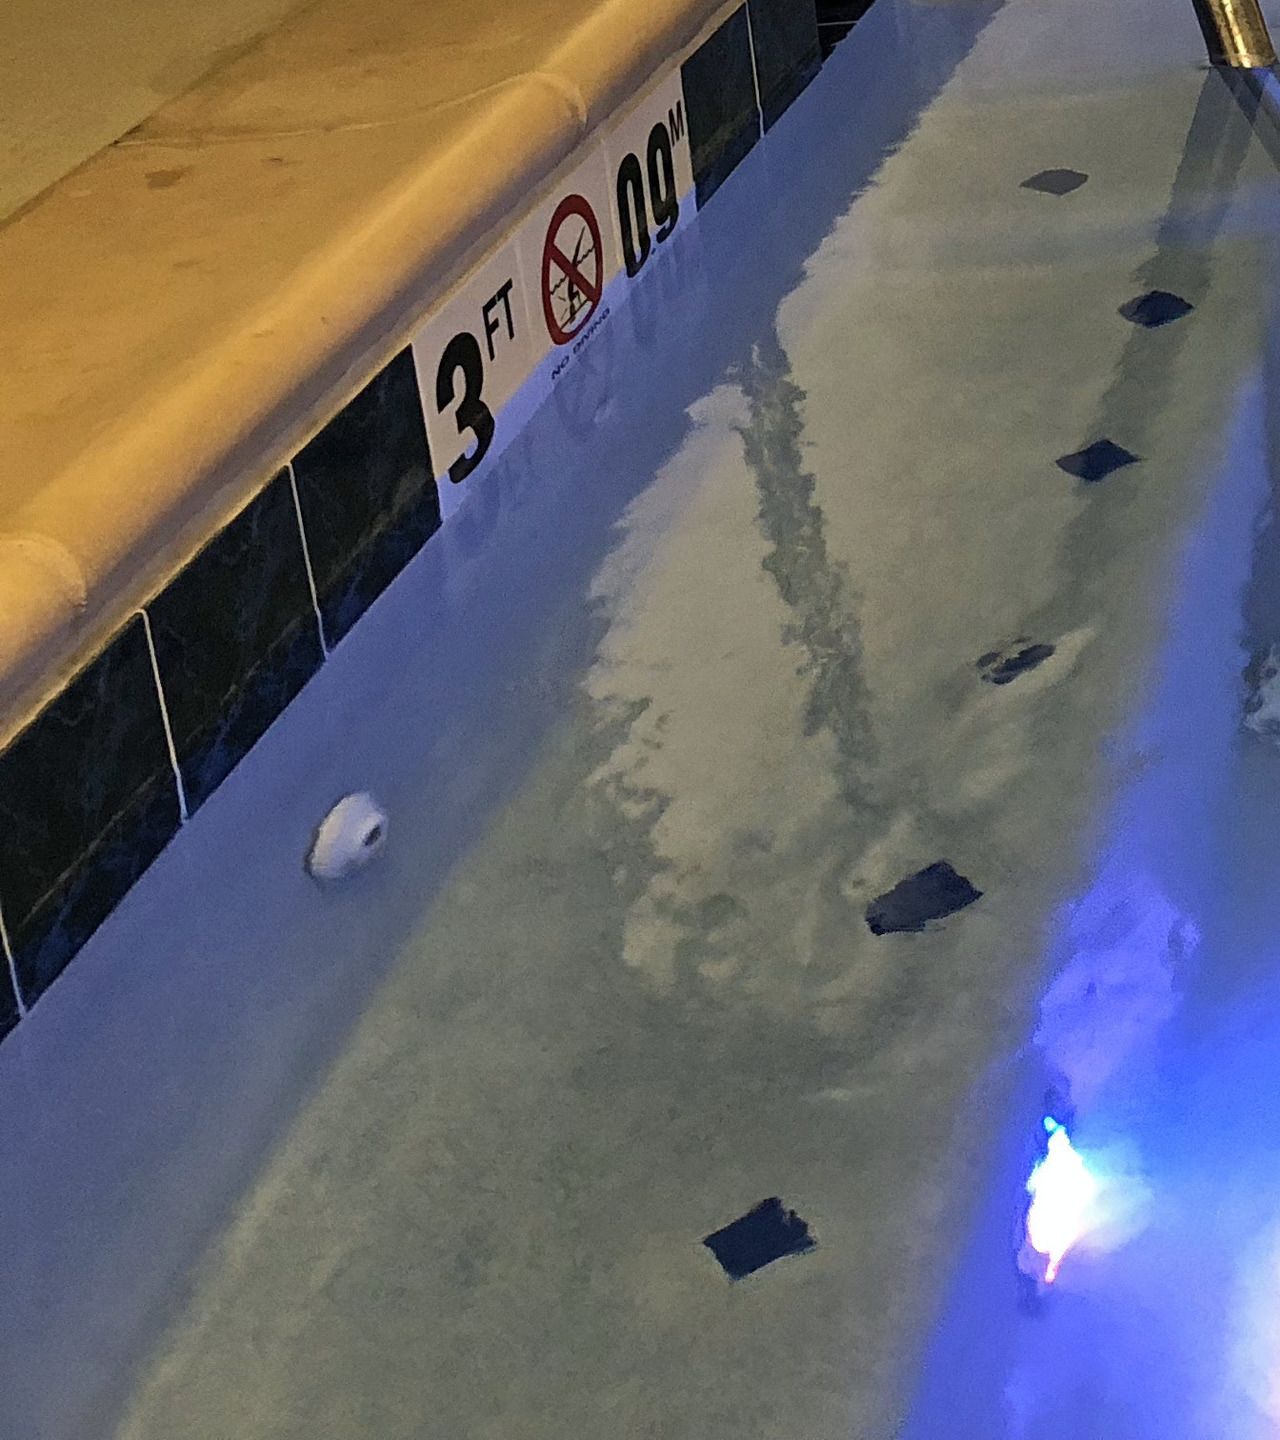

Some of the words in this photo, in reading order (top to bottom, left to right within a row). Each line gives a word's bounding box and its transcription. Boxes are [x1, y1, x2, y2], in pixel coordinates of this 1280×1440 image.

[668, 101, 686, 148] M
[436, 331, 495, 484] 3
[482, 279, 515, 361] FT
[551, 355, 570, 380] NO
